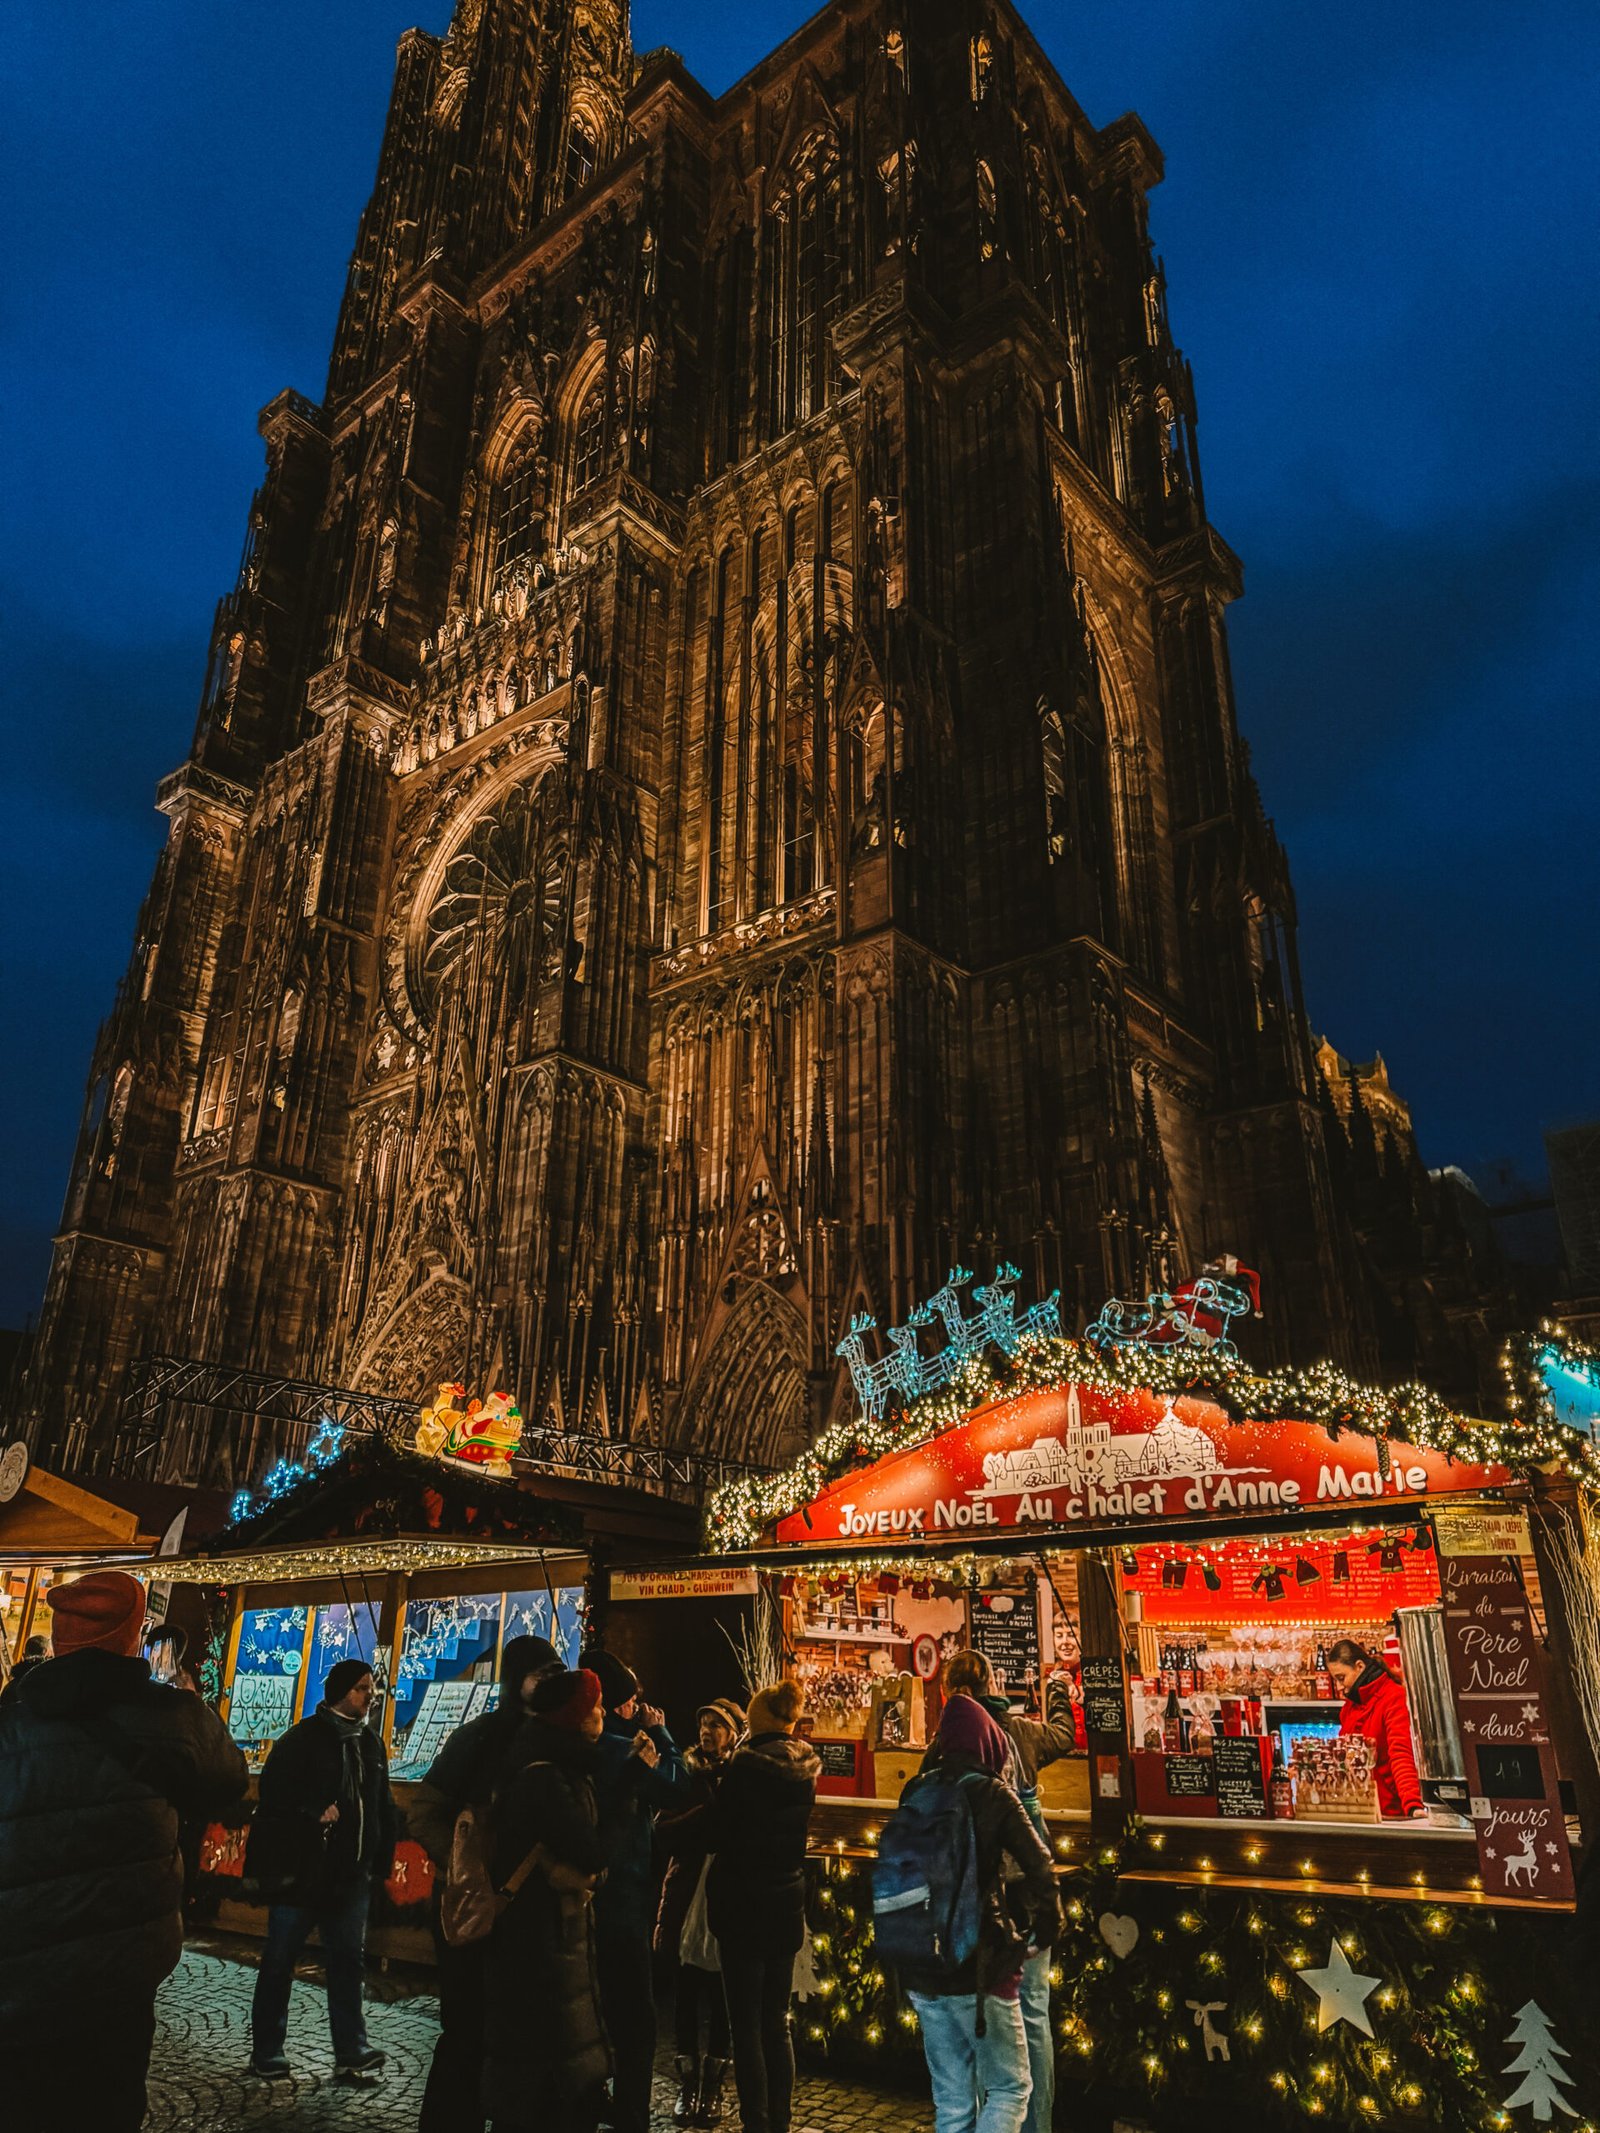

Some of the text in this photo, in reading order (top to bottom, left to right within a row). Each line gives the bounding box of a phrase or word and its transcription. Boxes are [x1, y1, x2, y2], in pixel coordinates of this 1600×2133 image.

[1015, 1493, 1053, 1523] Au
[1184, 1475, 1300, 1511] d'Anne
[1316, 1460, 1427, 1499] Marie
[1444, 1561, 1518, 1588] Livraison
[639, 1585, 654, 1595] VIN
[657, 1583, 685, 1595] CHAUD
[1475, 1595, 1495, 1618] du
[1458, 1625, 1522, 1655] Père
[1462, 1657, 1530, 1692] Noël
[1480, 1713, 1526, 1740] dans
[1484, 1806, 1551, 1837] jours
